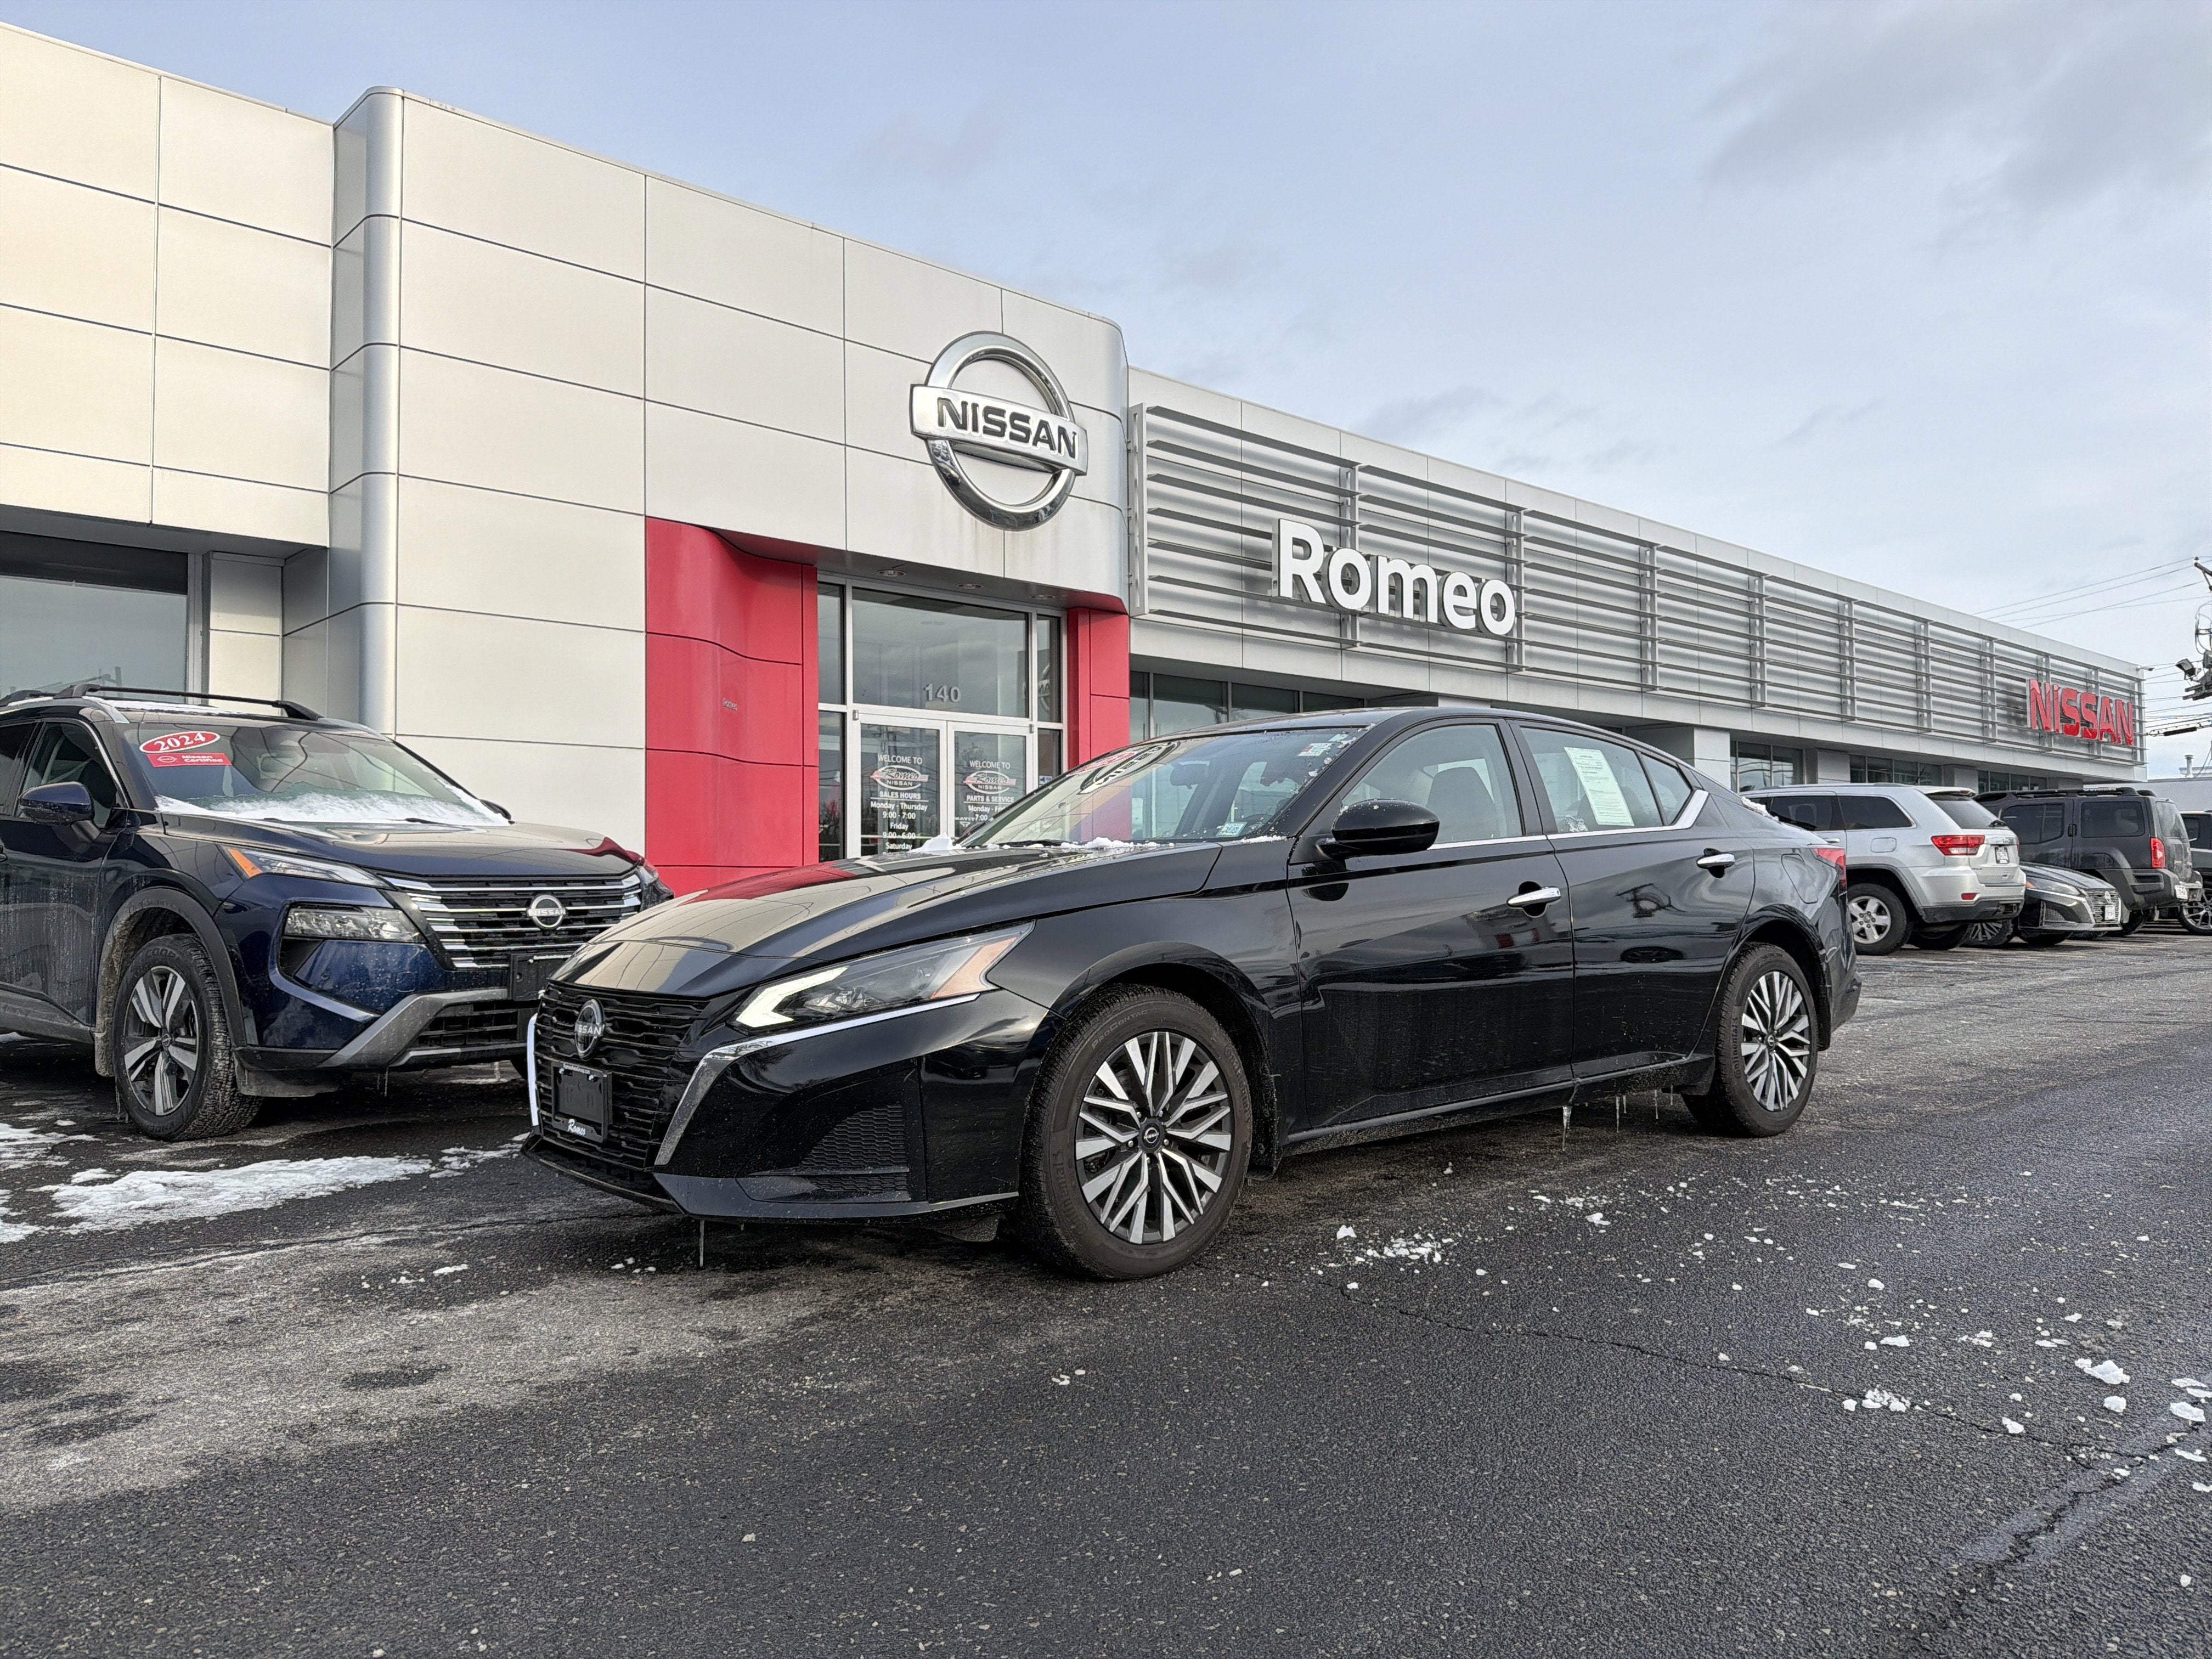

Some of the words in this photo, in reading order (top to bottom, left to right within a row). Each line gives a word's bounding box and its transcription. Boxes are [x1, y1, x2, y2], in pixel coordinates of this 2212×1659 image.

[936, 396, 1079, 460] NISSAN
[1277, 518, 1516, 636] Romeo
[924, 684, 961, 702] 140
[2029, 678, 2134, 746] NISSAN
[154, 732, 206, 751] 2024
[878, 754, 911, 764] WELCOME
[912, 757, 923, 765] TO
[969, 760, 1000, 769] WELCOME
[881, 767, 919, 780] Romeo
[974, 772, 1008, 785] Romeo
[900, 792, 921, 800] HOURS
[870, 800, 895, 810] Monday
[900, 802, 928, 812] Thursday
[968, 804, 991, 813] Monday
[902, 811, 916, 820] 7:00
[890, 822, 909, 831] Friday
[885, 842, 913, 851] Saturday
